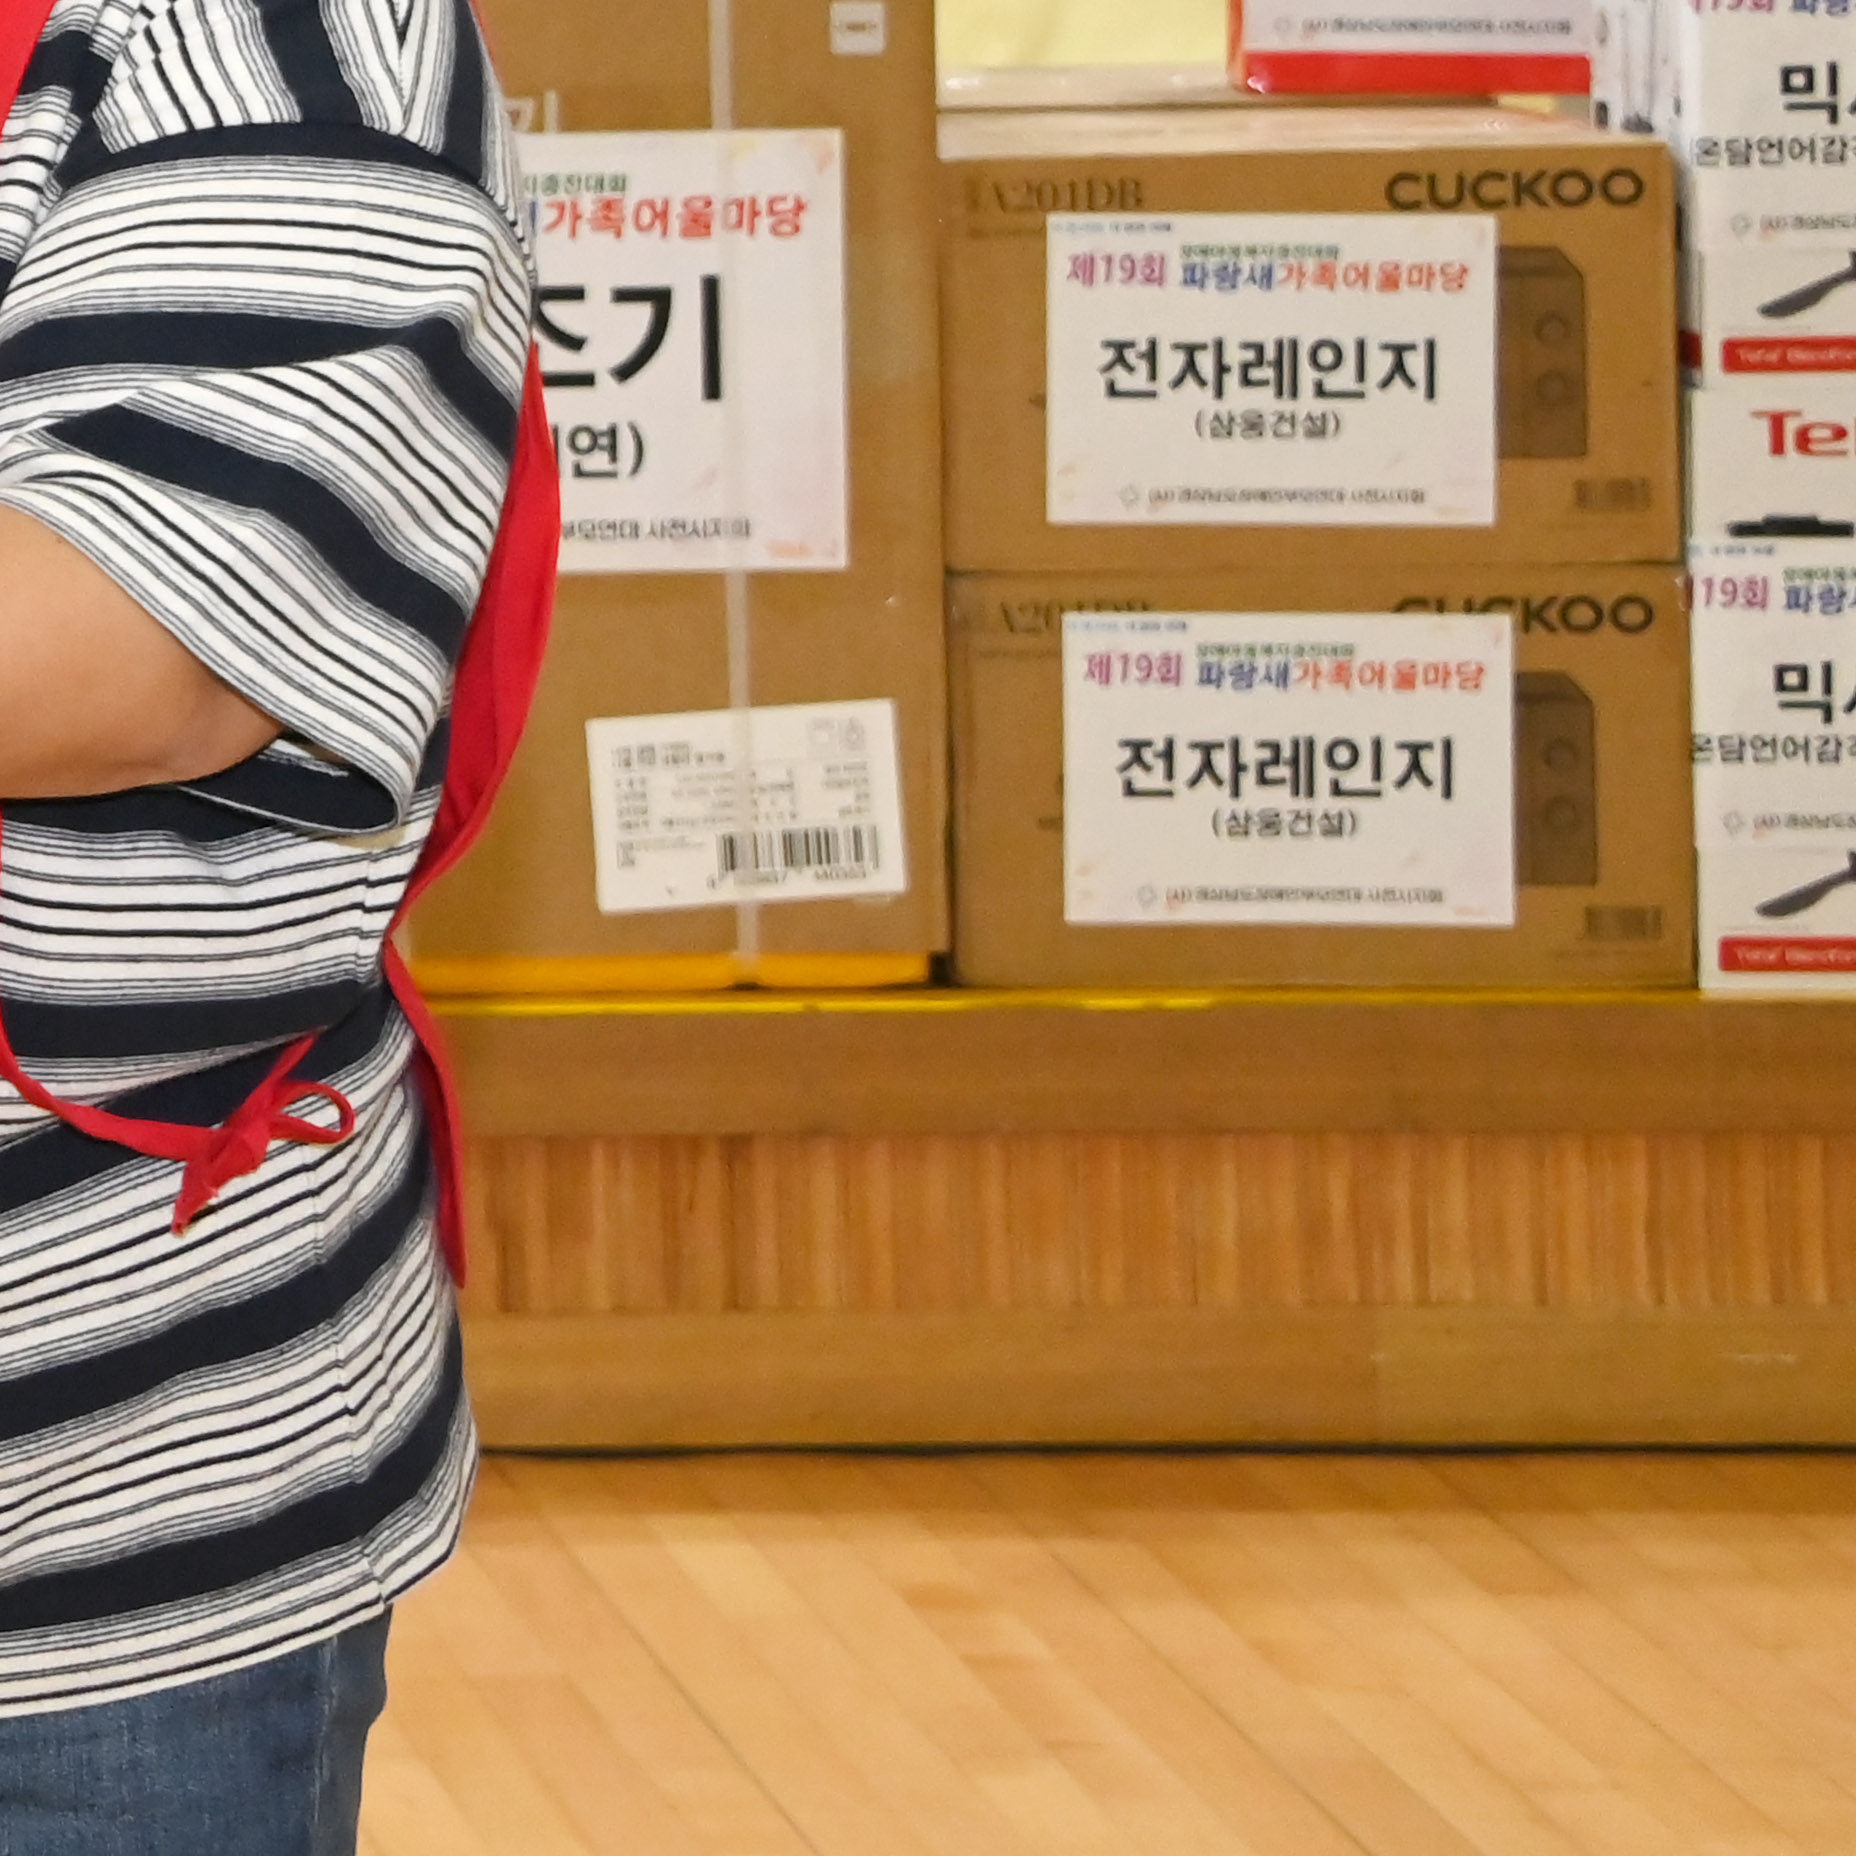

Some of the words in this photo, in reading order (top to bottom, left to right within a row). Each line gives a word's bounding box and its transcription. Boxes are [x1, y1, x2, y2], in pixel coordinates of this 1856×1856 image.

[1779, 61, 1856, 126] 믹
[1384, 167, 1646, 212] CUCKOO
[1097, 334, 1440, 402] 전자레인지
[1773, 660, 1856, 725] 믹
[1113, 734, 1457, 802] 전자레인지
